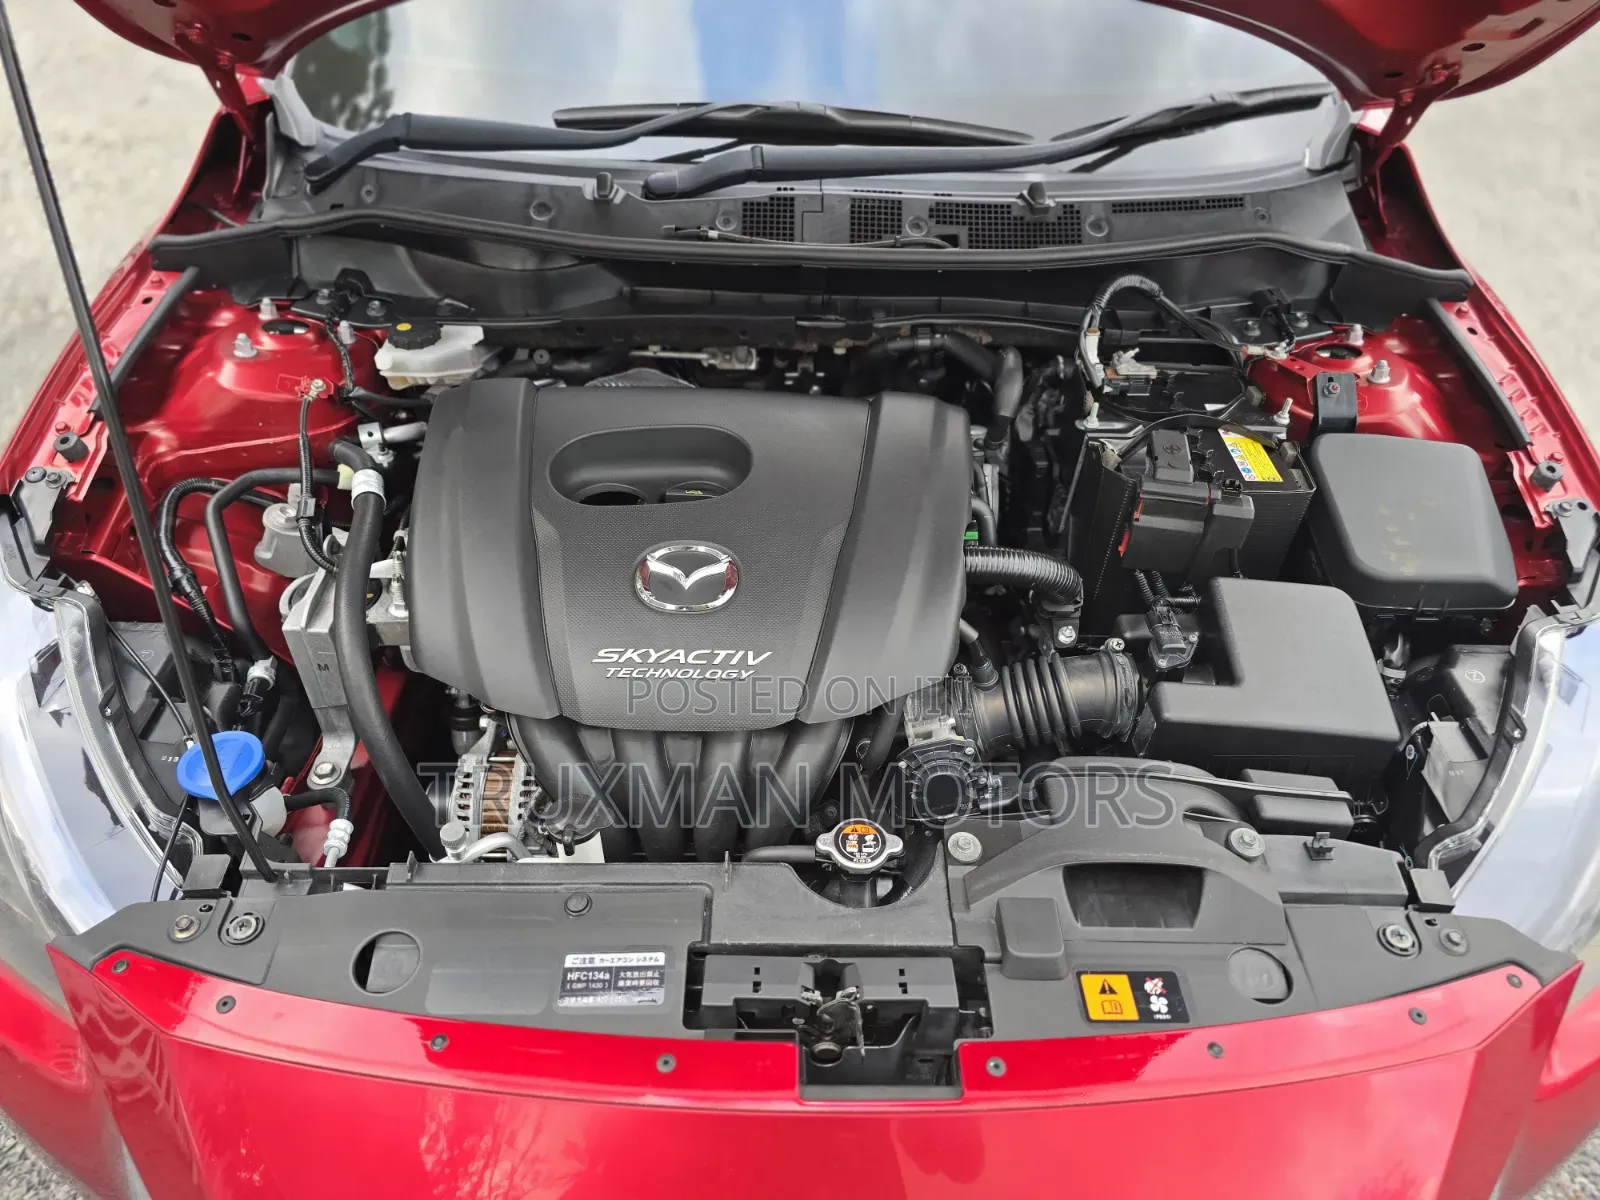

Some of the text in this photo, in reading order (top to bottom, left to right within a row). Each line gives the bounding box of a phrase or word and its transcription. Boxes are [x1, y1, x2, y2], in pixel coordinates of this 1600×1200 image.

[592, 648, 773, 666] SKYACTIV
[605, 667, 756, 681] TECHNOLOGY
[566, 971, 611, 980] HFC134a
